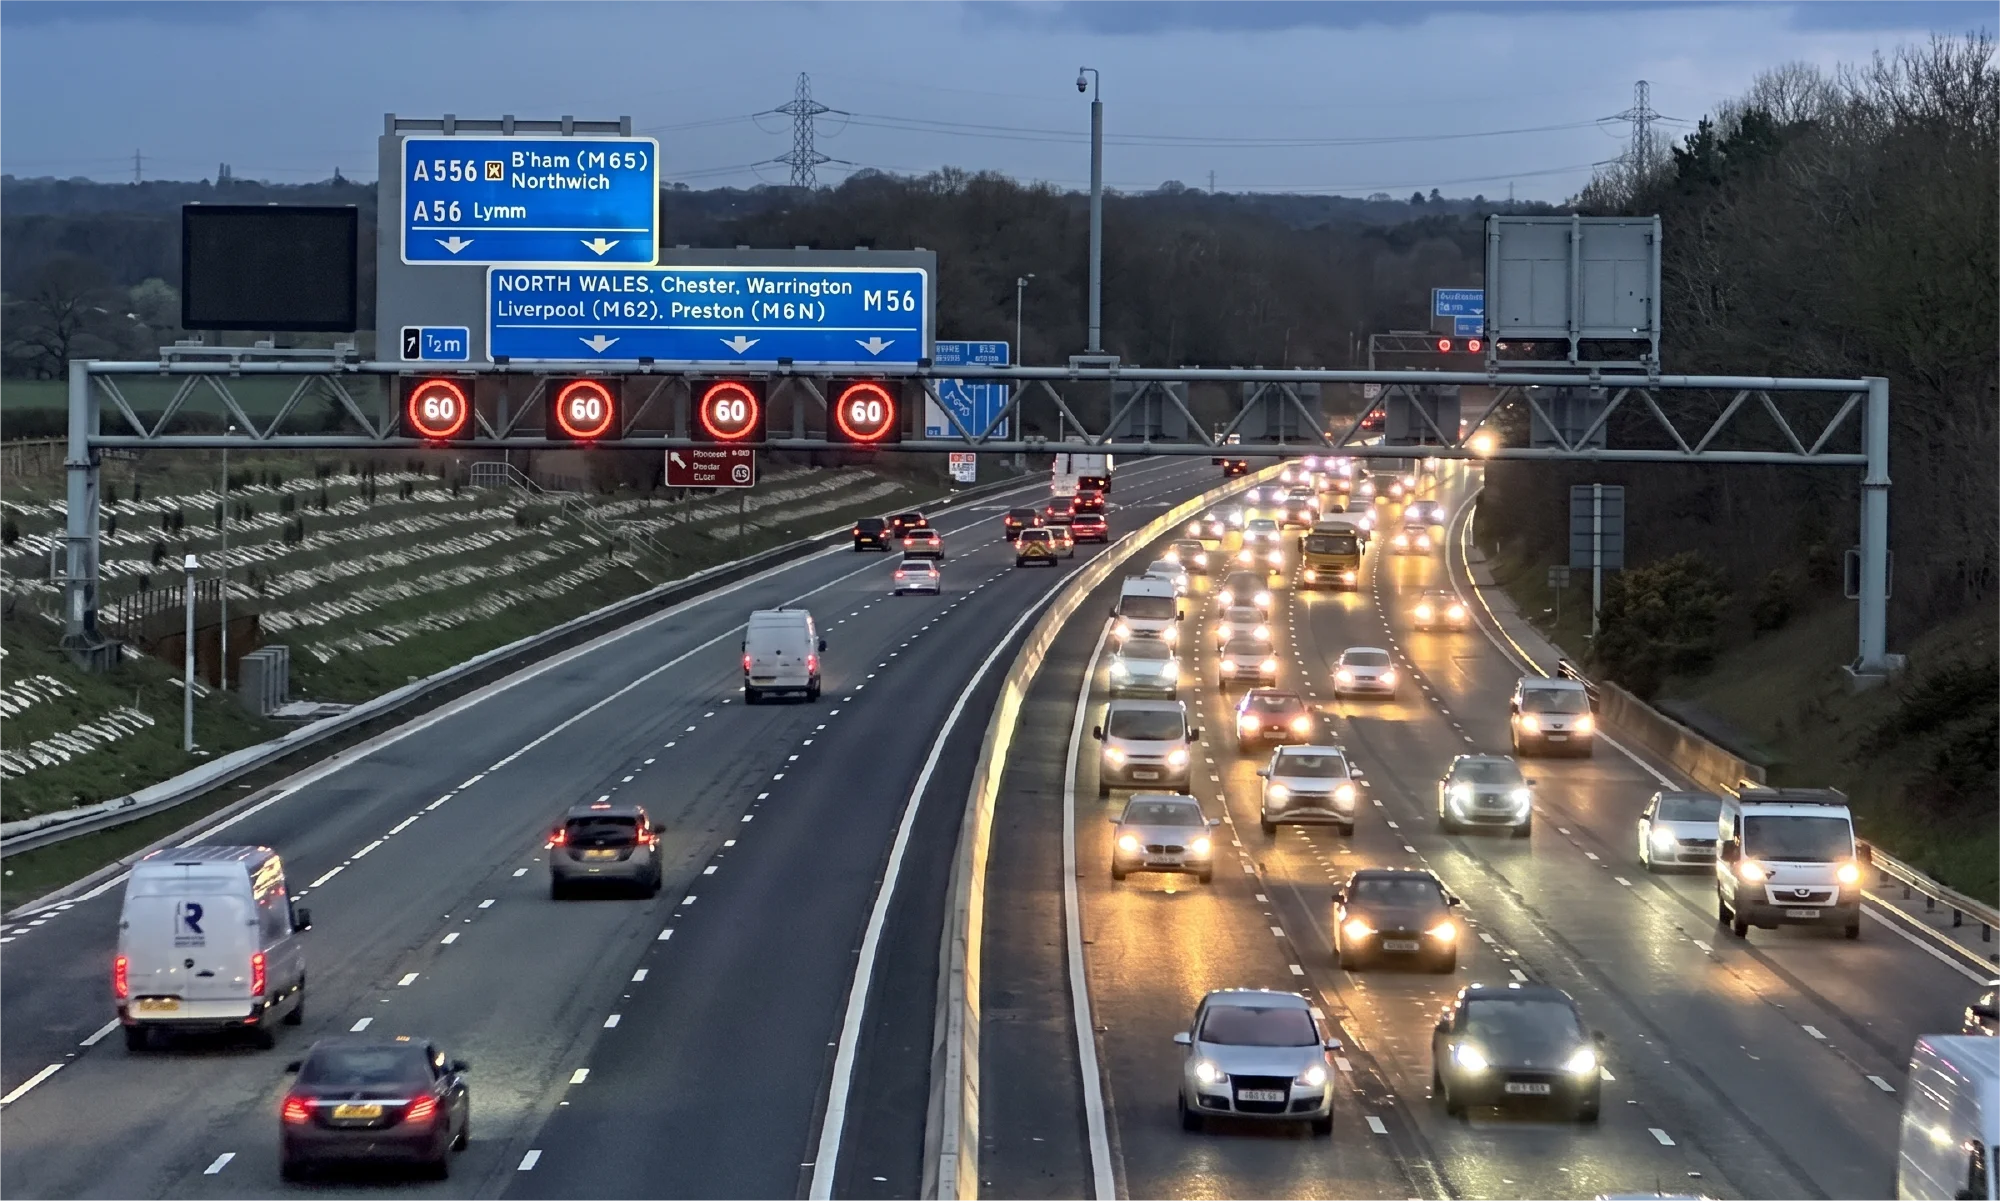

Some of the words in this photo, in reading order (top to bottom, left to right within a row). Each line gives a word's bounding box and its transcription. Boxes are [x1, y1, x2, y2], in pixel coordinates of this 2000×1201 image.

[512, 151, 570, 168] B'ham
[512, 172, 610, 190] Northwich
[413, 200, 462, 222] A56
[474, 202, 527, 221] Lymm
[498, 275, 571, 292] NORTH
[661, 276, 740, 295] Chester,
[747, 277, 853, 297] Warrington
[498, 300, 586, 320] Liverpool
[671, 302, 744, 320] Preston
[864, 290, 915, 312] M56
[424, 396, 454, 420] 60
[571, 398, 601, 421] 60
[715, 399, 746, 422] 60
[851, 400, 881, 423] 60
